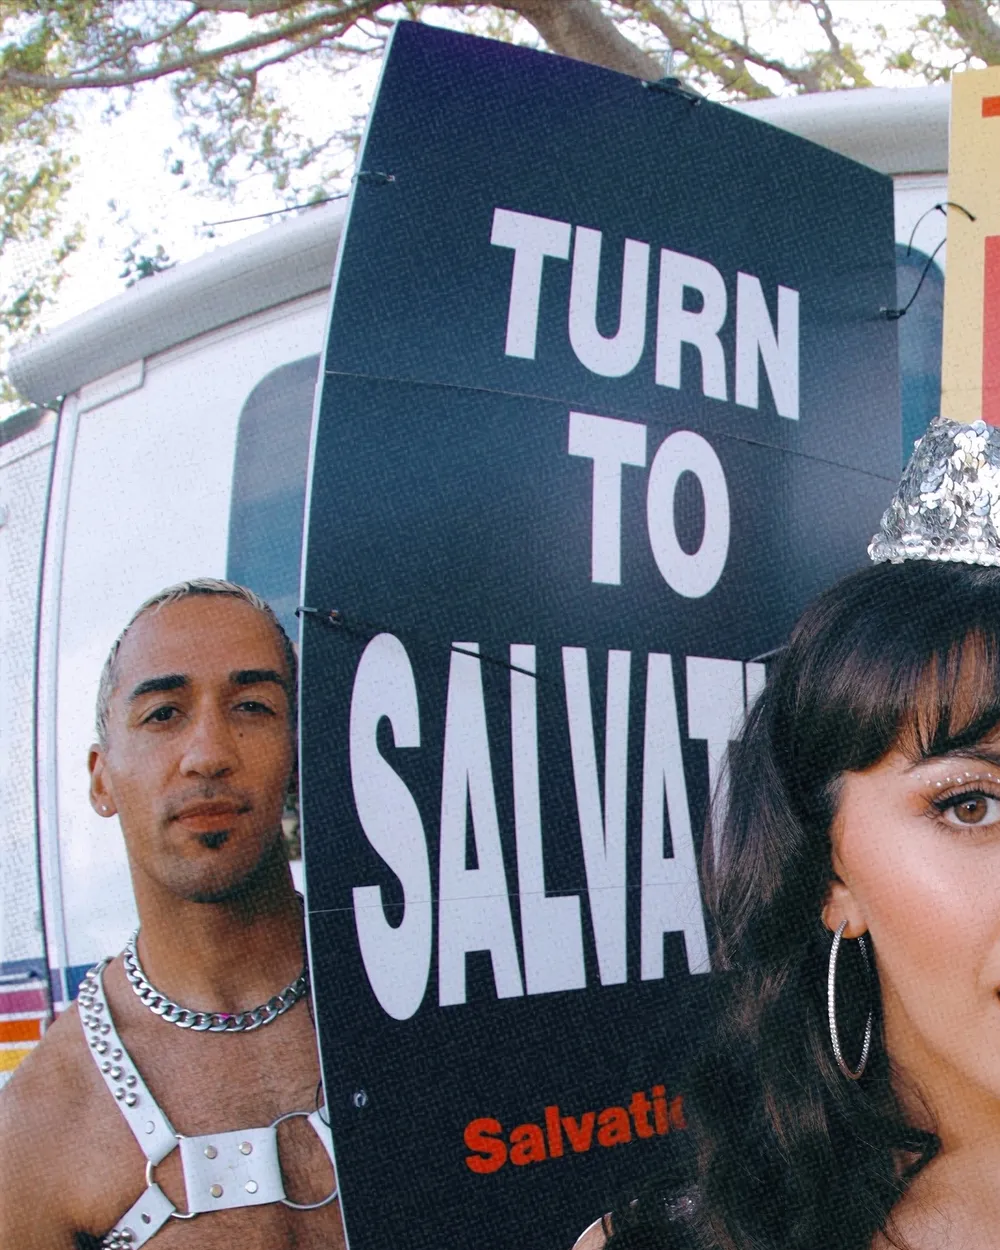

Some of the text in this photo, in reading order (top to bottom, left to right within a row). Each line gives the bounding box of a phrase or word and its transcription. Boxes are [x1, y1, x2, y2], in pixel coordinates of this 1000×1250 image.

[490, 207, 799, 421] TURN
[568, 411, 730, 599] TO
[349, 632, 766, 1020] SALVAT
